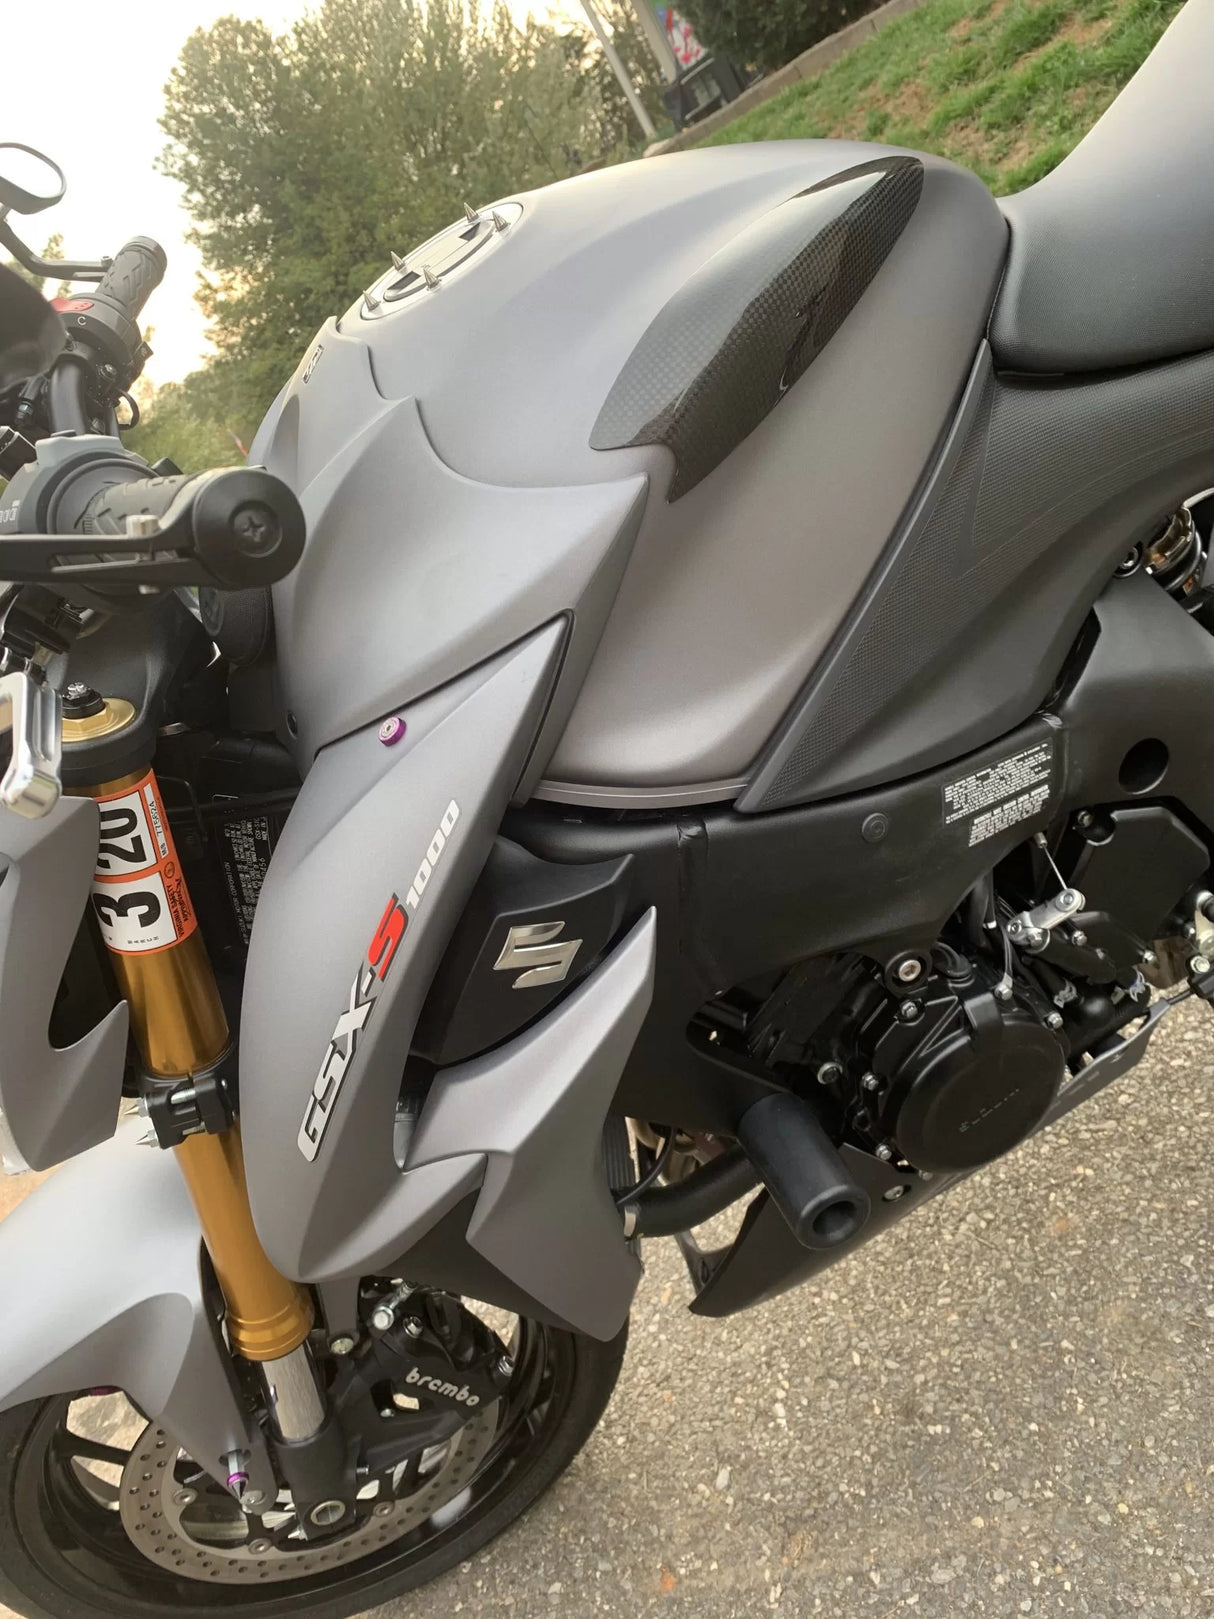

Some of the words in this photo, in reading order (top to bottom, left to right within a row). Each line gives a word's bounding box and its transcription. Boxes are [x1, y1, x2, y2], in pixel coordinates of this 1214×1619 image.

[97, 808, 147, 869] 20
[92, 892, 161, 928] 3
[172, 906, 185, 938] VIRGINIA
[405, 1367, 480, 1407] brembo
